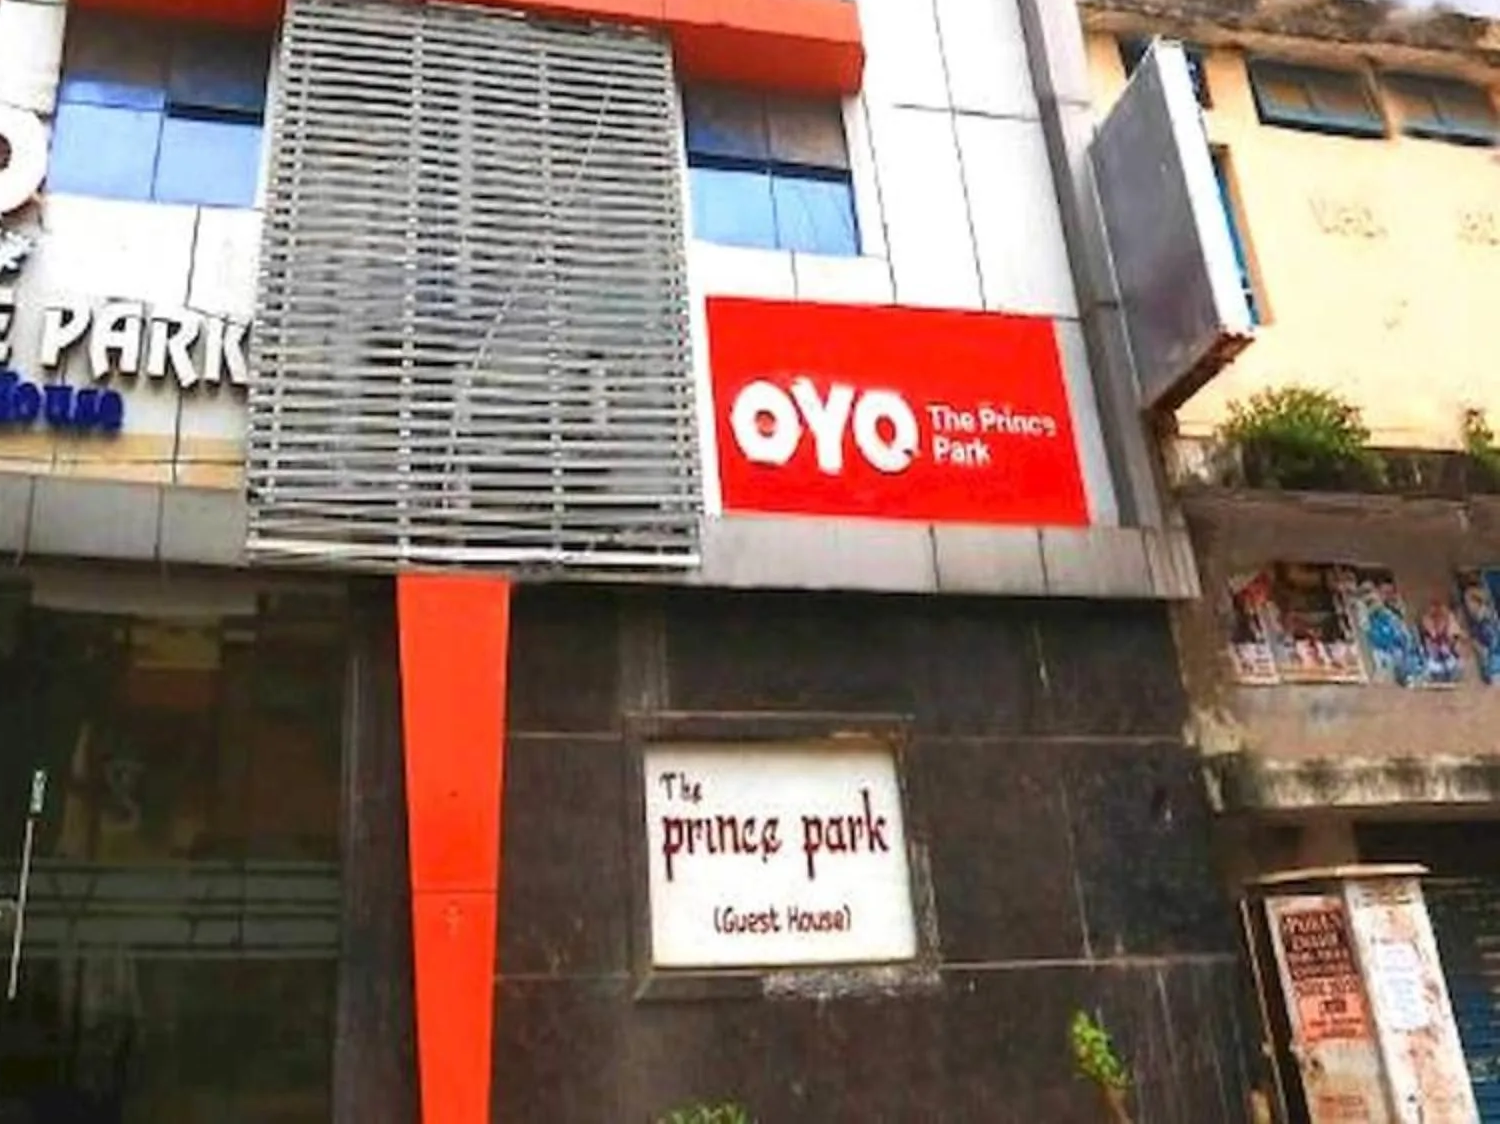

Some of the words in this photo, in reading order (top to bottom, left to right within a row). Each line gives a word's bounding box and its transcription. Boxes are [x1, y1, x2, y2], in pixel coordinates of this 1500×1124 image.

[41, 300, 250, 388] PARK
[730, 375, 920, 474] OYO
[928, 406, 975, 431] The
[980, 407, 1057, 437] Prince
[932, 436, 991, 466] Park
[659, 772, 702, 802] The
[661, 814, 782, 882] prince
[801, 788, 889, 880] park
[713, 905, 780, 934] (Guest
[787, 902, 851, 933] House)
